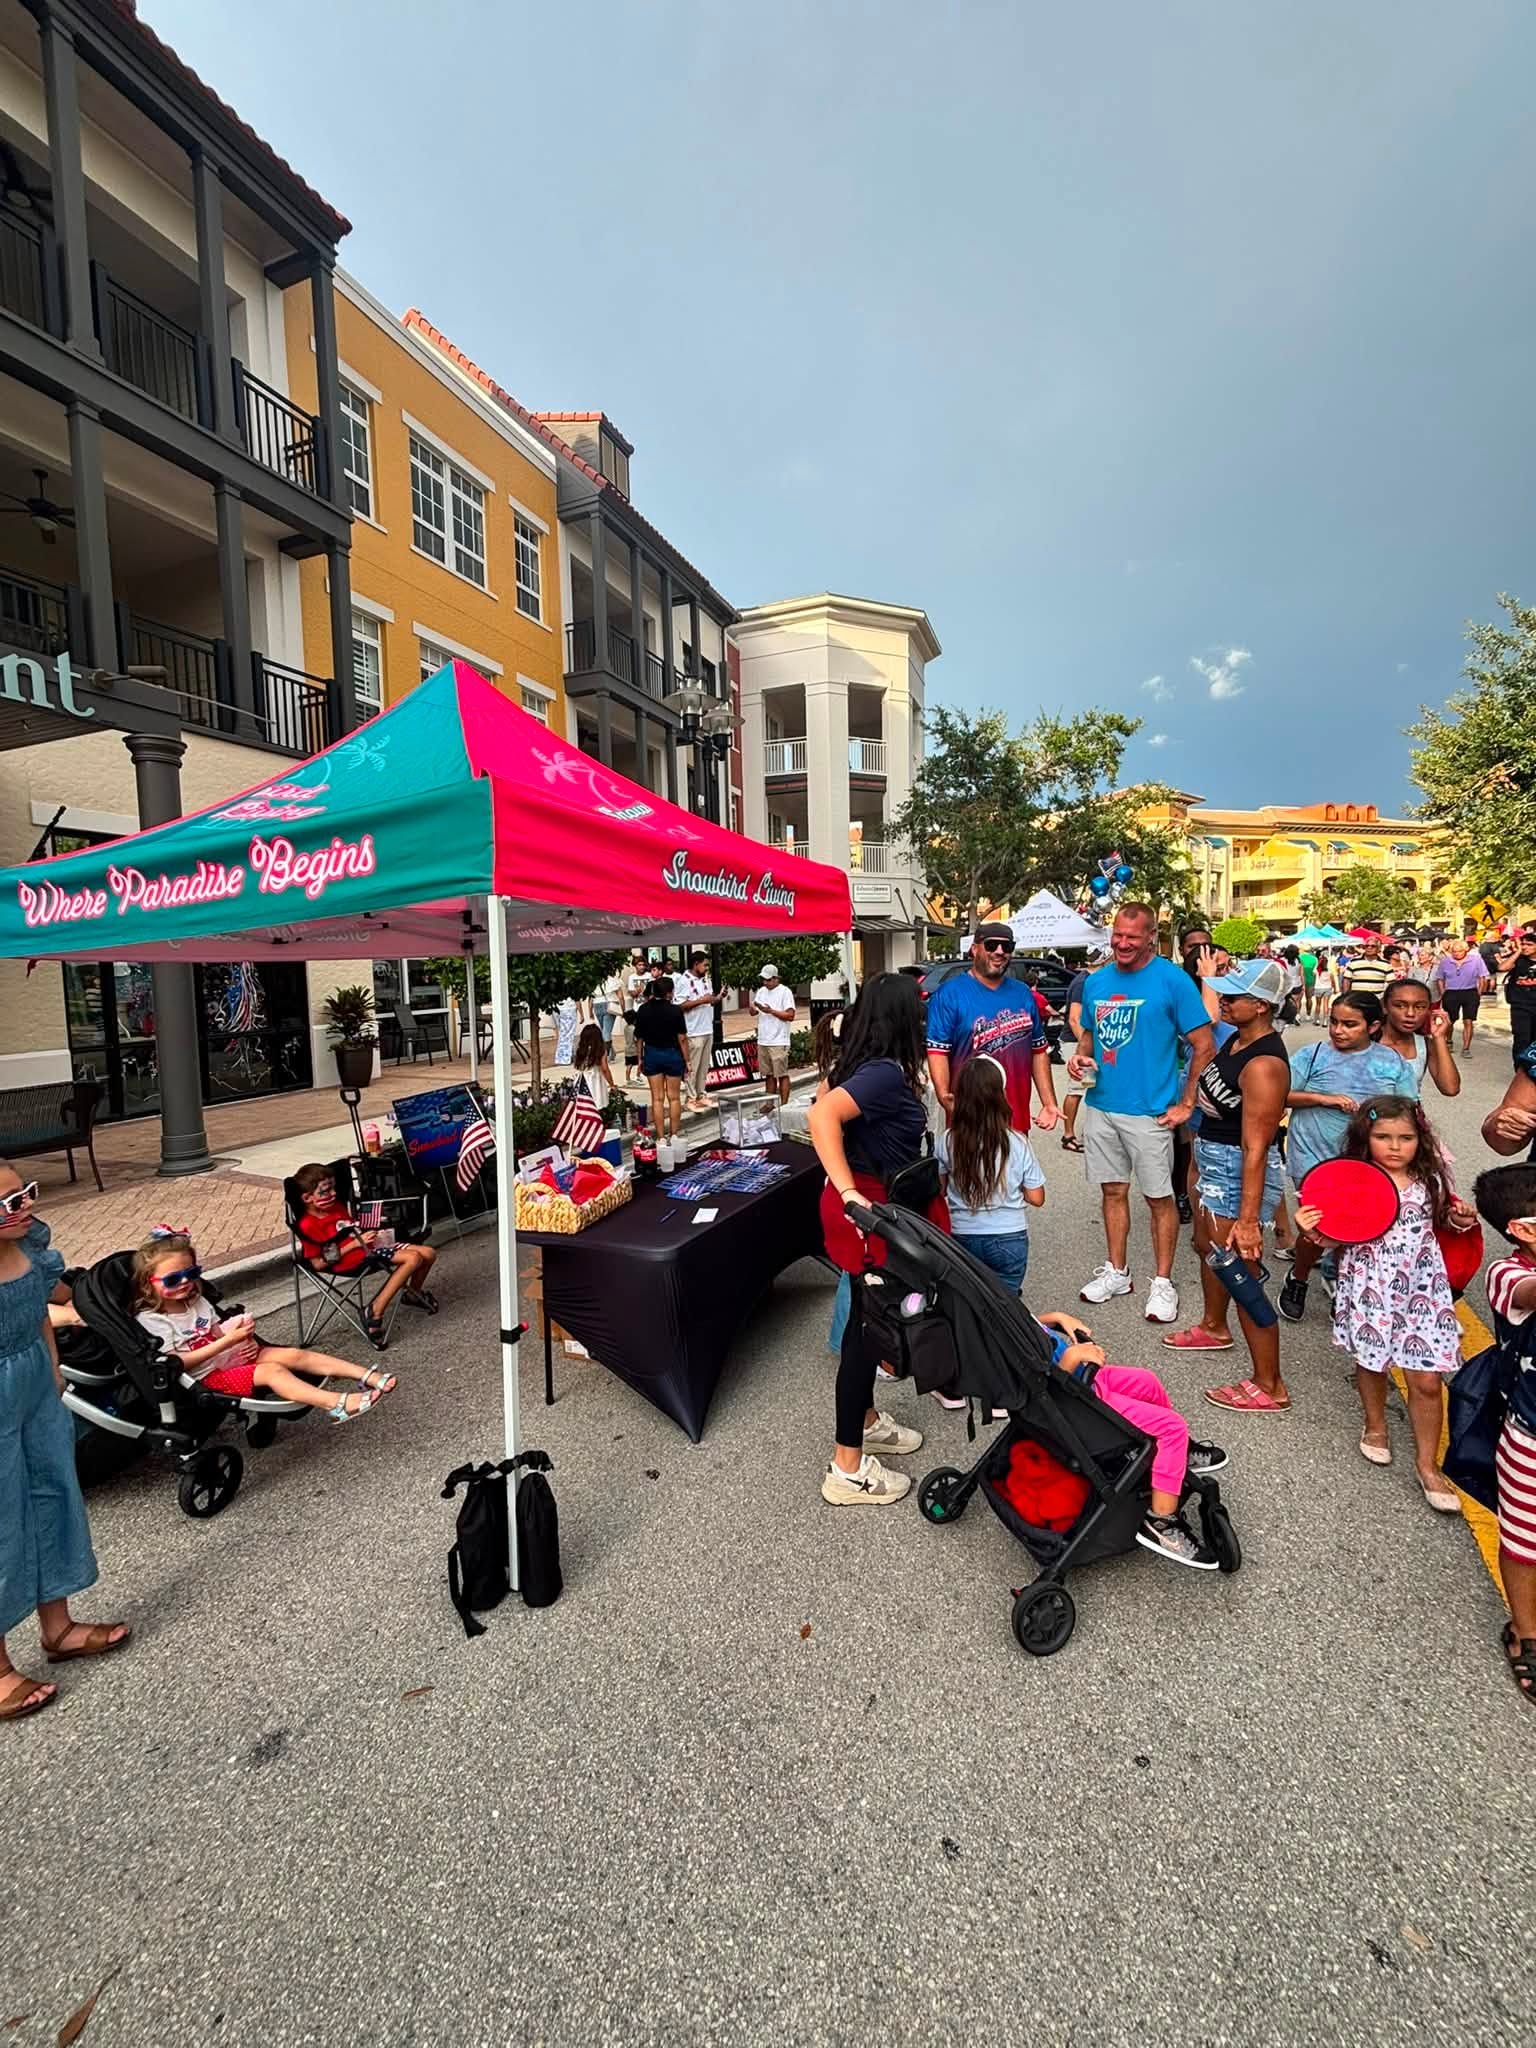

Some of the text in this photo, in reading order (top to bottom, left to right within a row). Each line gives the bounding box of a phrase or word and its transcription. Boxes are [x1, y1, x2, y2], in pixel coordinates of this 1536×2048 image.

[19, 835, 374, 926] Where Paradise Begins
[662, 850, 796, 915] Snowbird Living
[1110, 1008, 1132, 1025] Old
[1098, 1019, 1129, 1046] Style
[715, 1047, 744, 1067] OPEN
